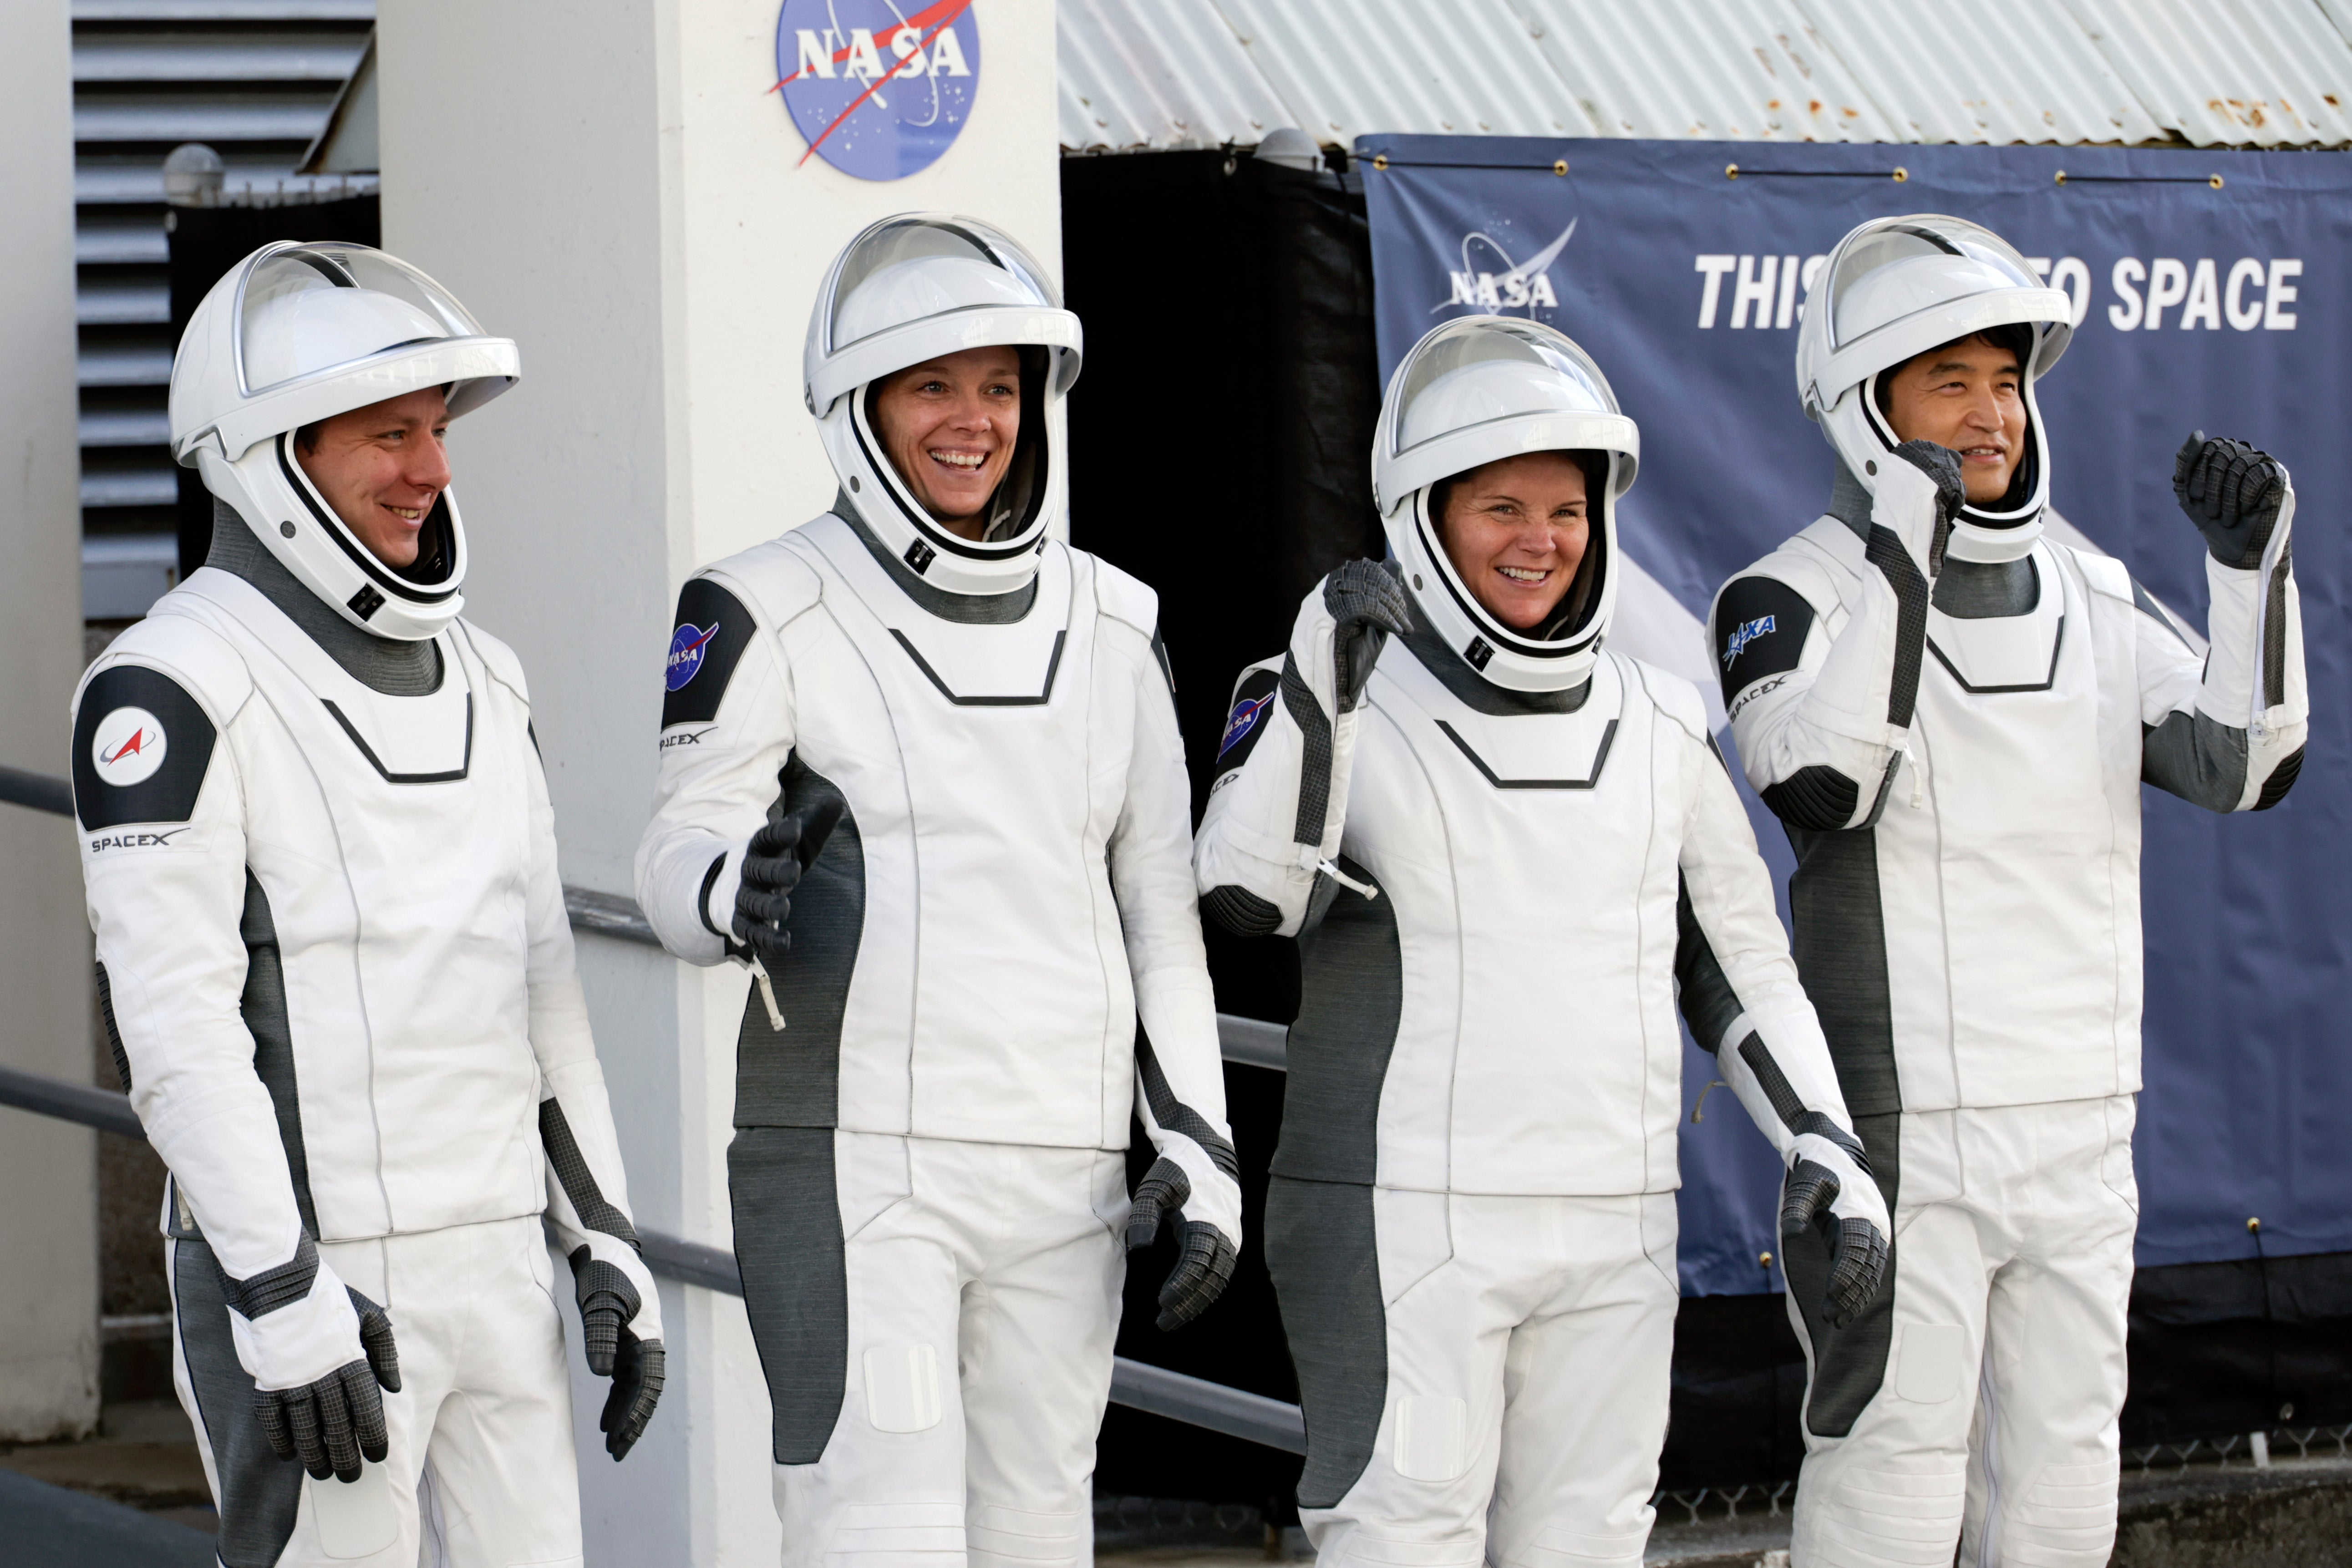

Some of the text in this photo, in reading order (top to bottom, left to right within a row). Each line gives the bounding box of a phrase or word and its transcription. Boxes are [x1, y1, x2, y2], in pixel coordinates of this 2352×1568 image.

[795, 26, 971, 80] NASA
[1450, 271, 1558, 307] NASA
[2108, 257, 2303, 332] SPACE
[668, 648, 698, 668] NASA
[1722, 615, 1776, 671] JAXA
[1730, 670, 1804, 724] SPACEX
[660, 726, 719, 752] PACEX
[92, 827, 191, 853] SPACEX
